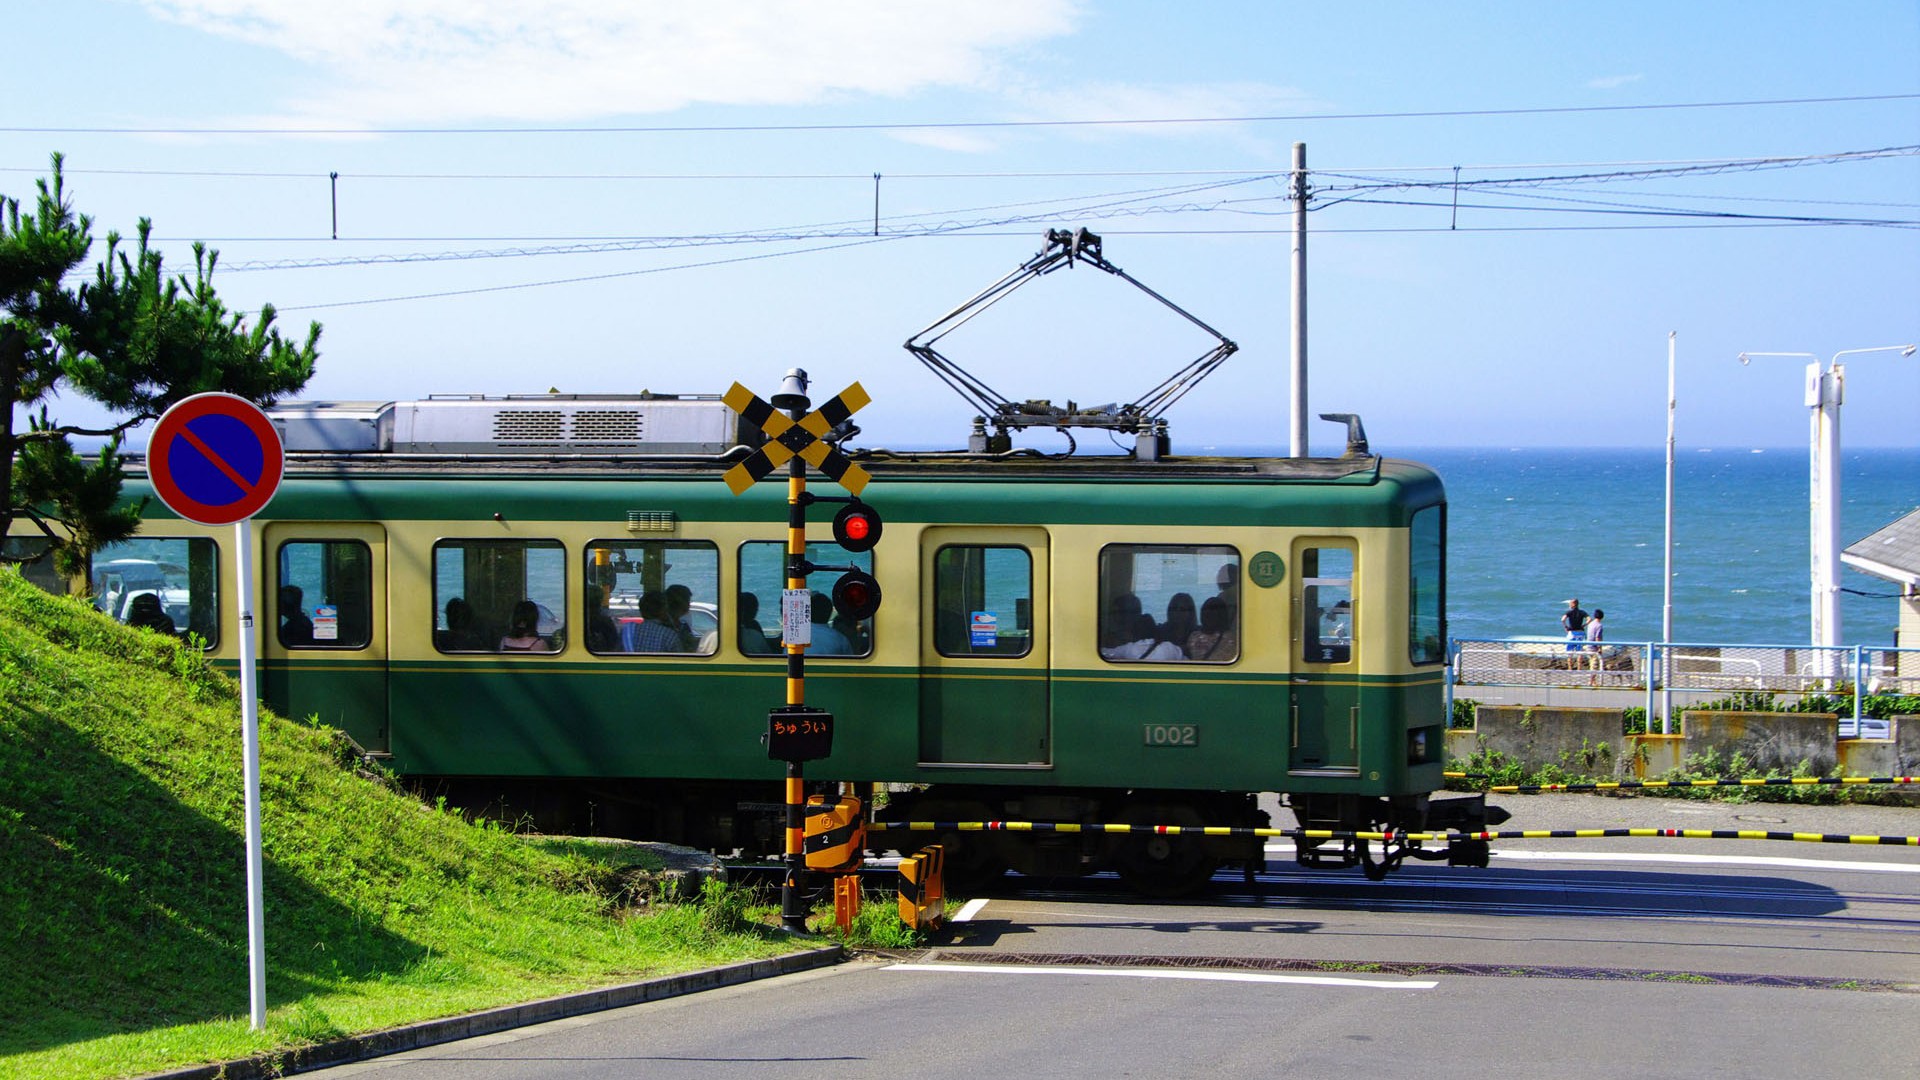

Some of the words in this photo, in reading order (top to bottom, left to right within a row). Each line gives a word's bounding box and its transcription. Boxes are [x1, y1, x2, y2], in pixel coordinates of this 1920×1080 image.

[774, 720, 827, 734] ちゅうい
[1145, 725, 1195, 745] 1002
[822, 835, 829, 844] 2
